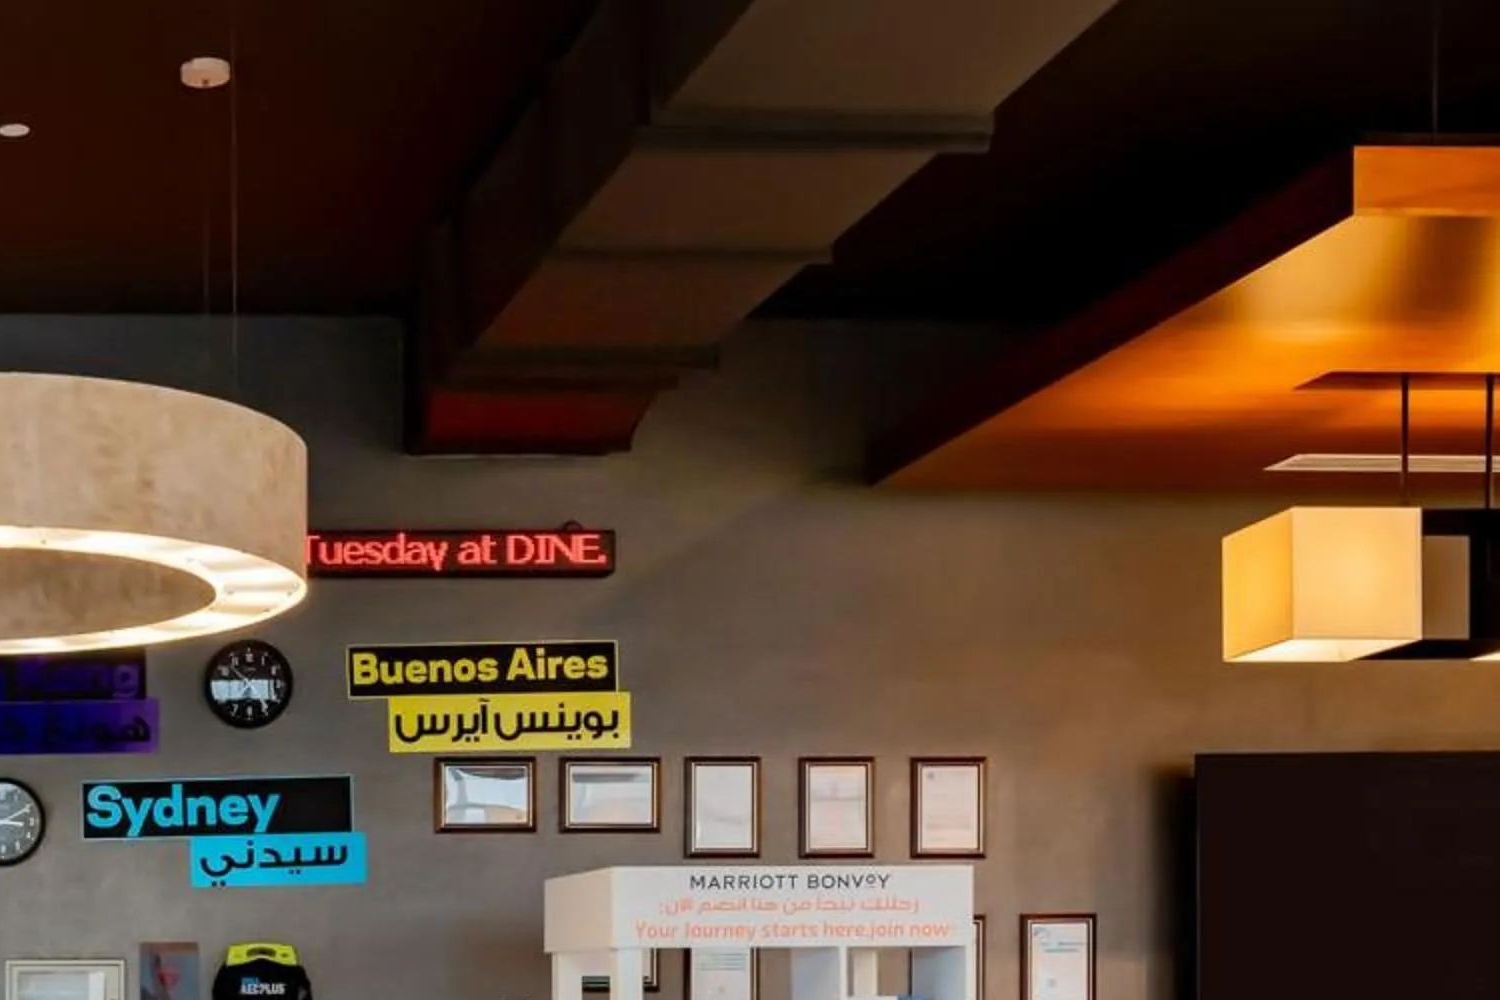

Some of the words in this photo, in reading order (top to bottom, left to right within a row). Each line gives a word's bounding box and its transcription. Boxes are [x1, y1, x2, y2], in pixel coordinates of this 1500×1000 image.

[458, 535, 497, 564] at
[352, 652, 499, 686] Buenos
[506, 646, 609, 682] Aires
[493, 702, 620, 742] بوينس
[86, 783, 282, 838] Sydney
[200, 839, 349, 887] سيدني
[690, 873, 799, 890] MARRIOTT
[635, 919, 678, 939] Your
[761, 919, 819, 939] starts
